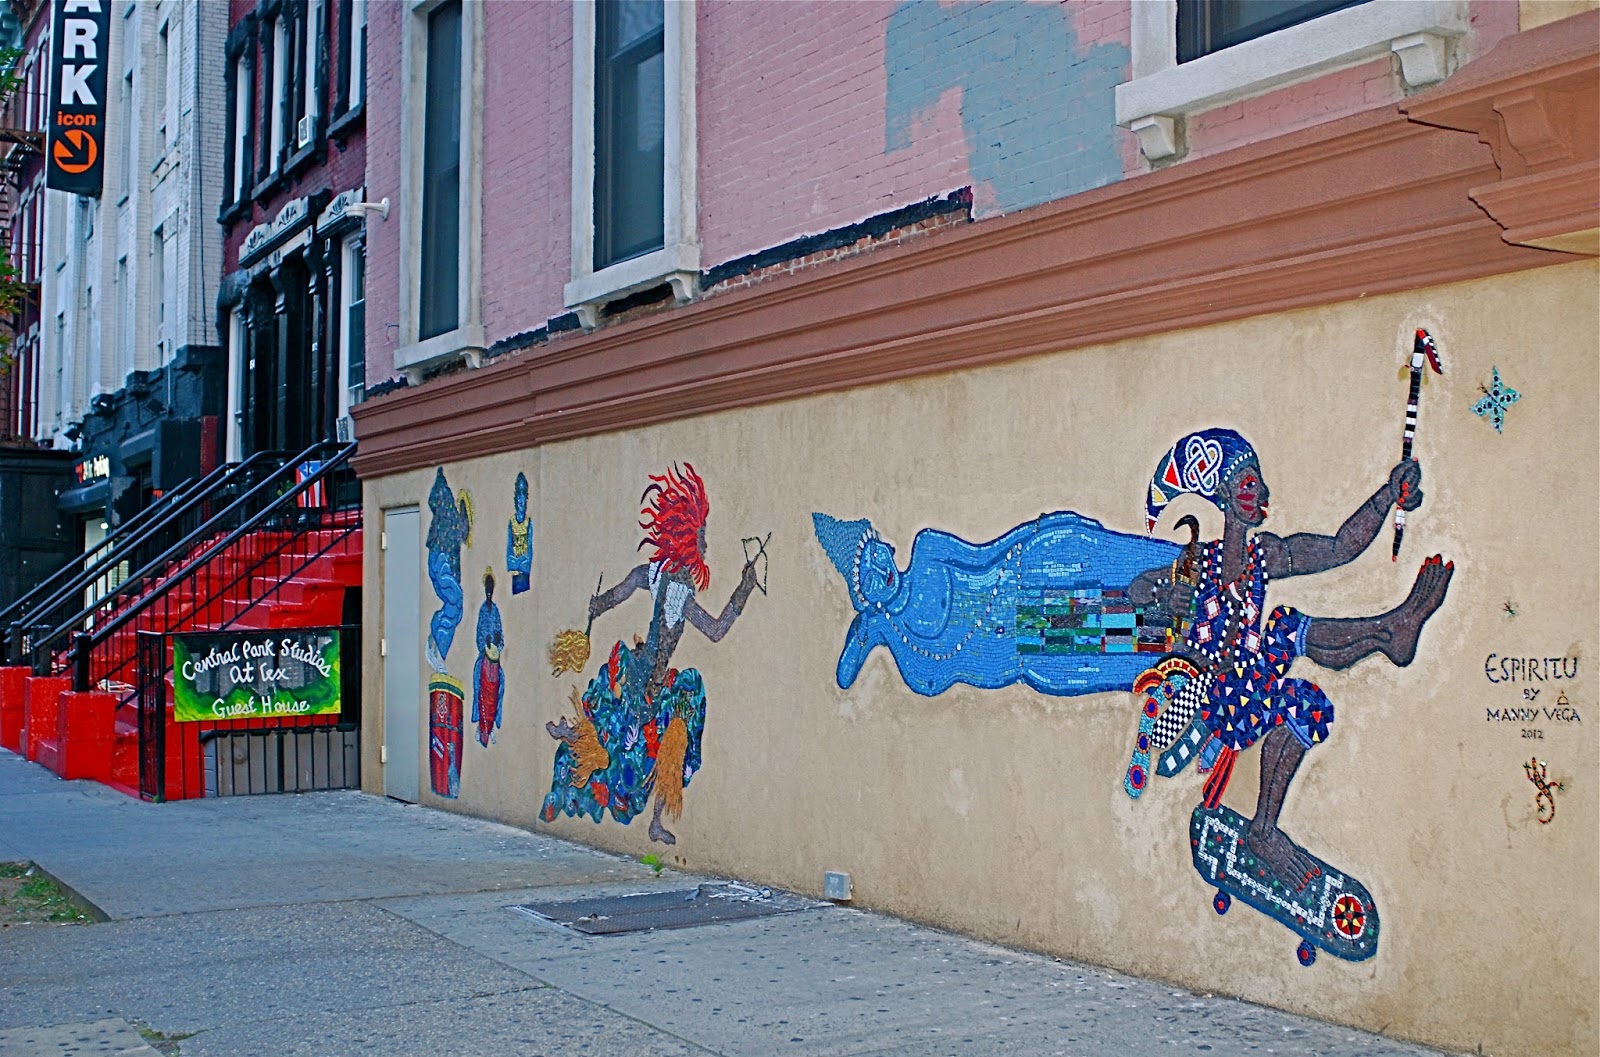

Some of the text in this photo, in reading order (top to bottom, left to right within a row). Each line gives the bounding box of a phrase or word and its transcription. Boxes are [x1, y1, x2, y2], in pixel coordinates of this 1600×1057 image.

[57, 110, 97, 126] icon
[182, 638, 332, 681] Central Park Studios
[1485, 653, 1578, 683] ESPIRITU
[1523, 687, 1541, 701] BY
[212, 696, 310, 718] Guest House
[1486, 707, 1581, 722] MANNY VEGA
[1521, 728, 1544, 740] 2012
